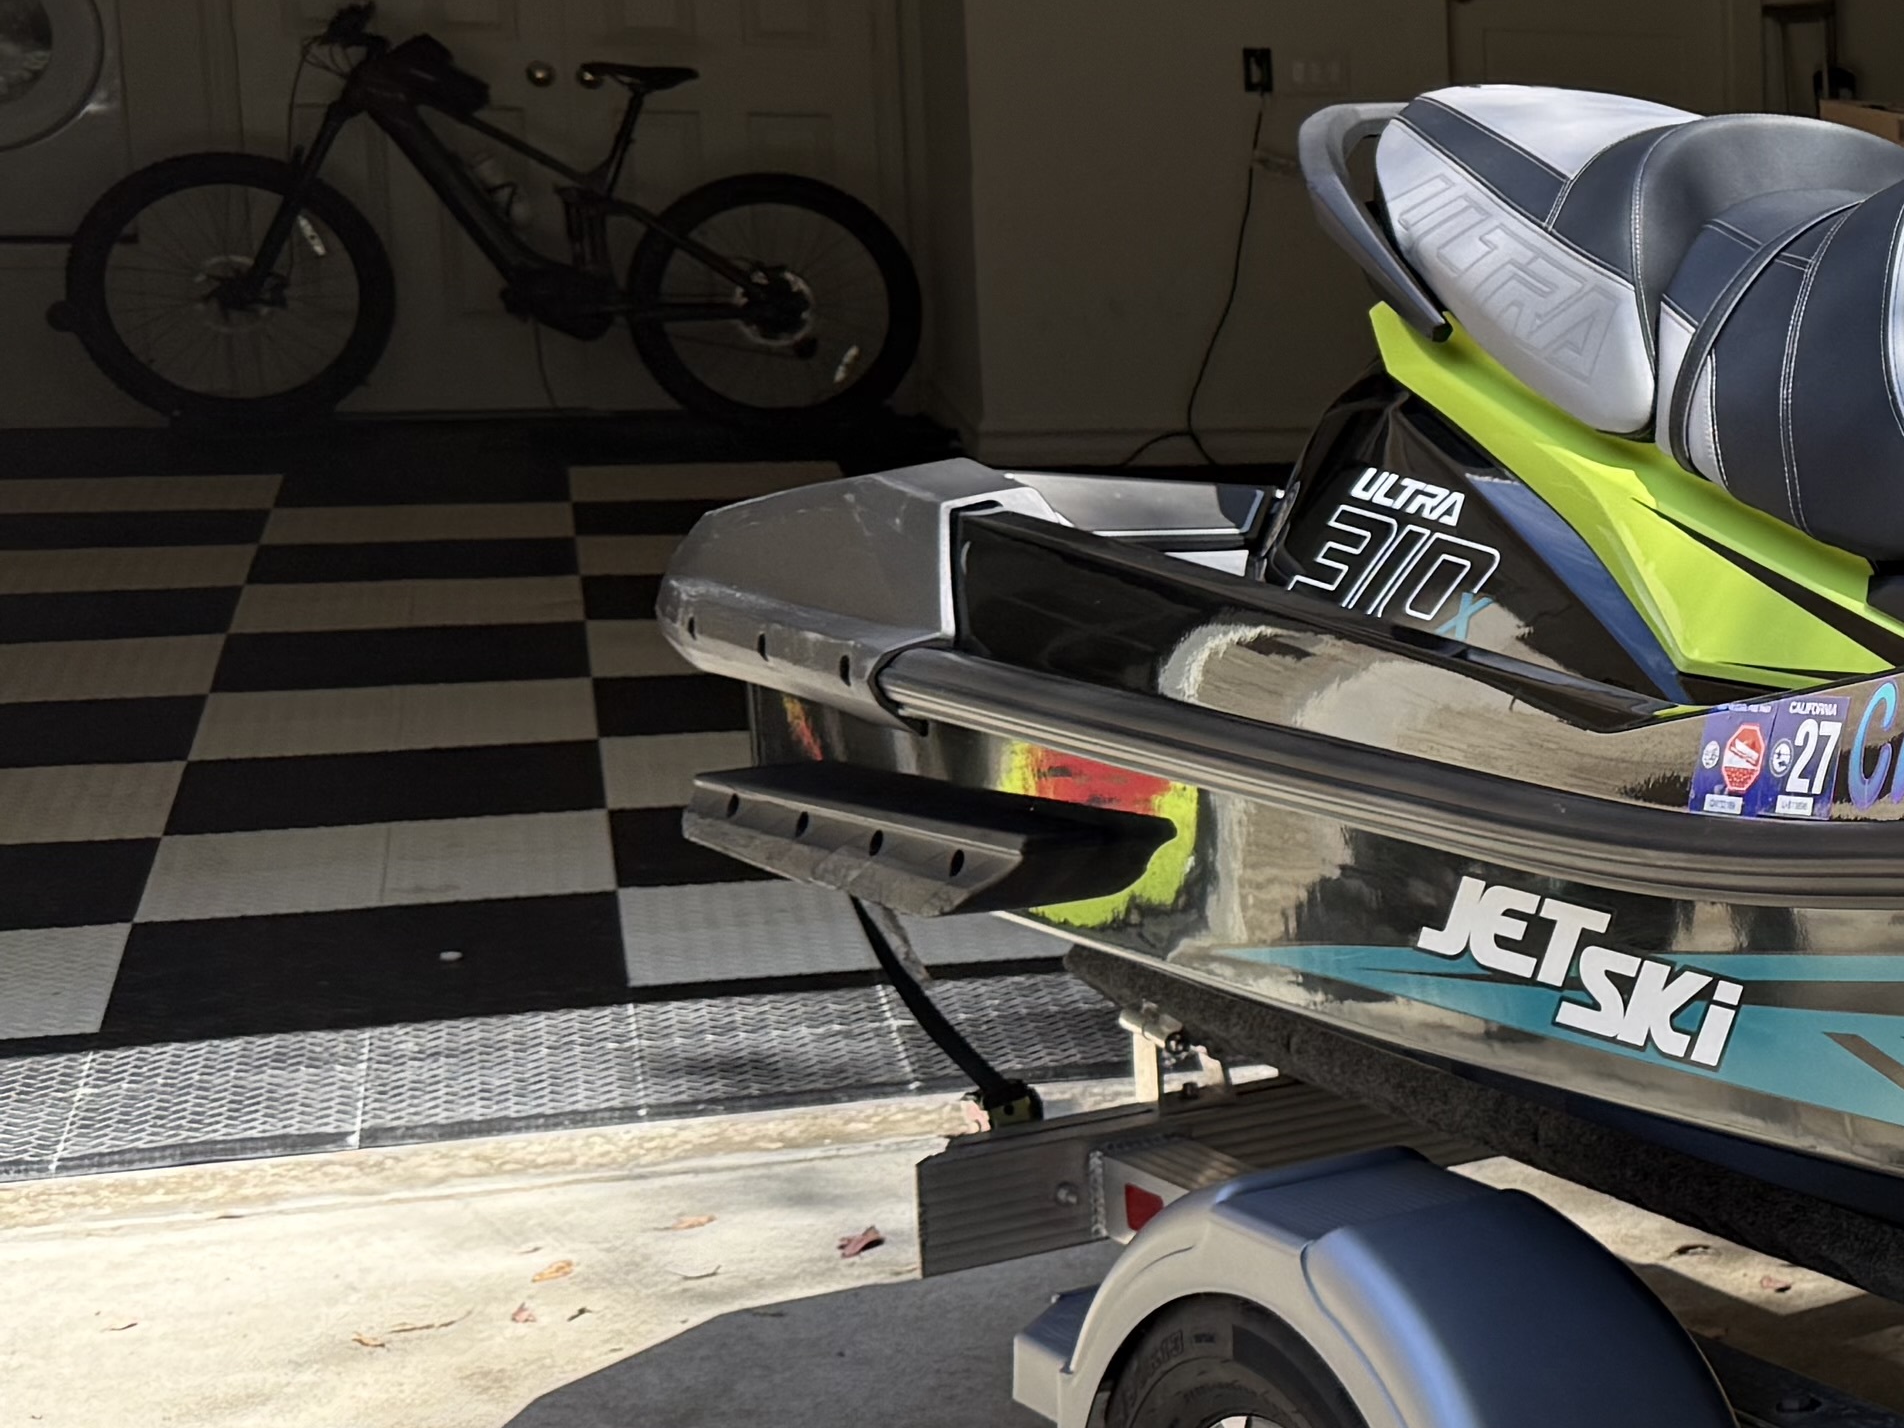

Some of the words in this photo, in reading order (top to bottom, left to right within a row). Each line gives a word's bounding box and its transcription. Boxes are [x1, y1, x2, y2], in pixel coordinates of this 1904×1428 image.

[1351, 467, 1465, 527] ULTRA
[1789, 701, 1838, 716] CALIFORNIA
[1786, 718, 1843, 795] 27
